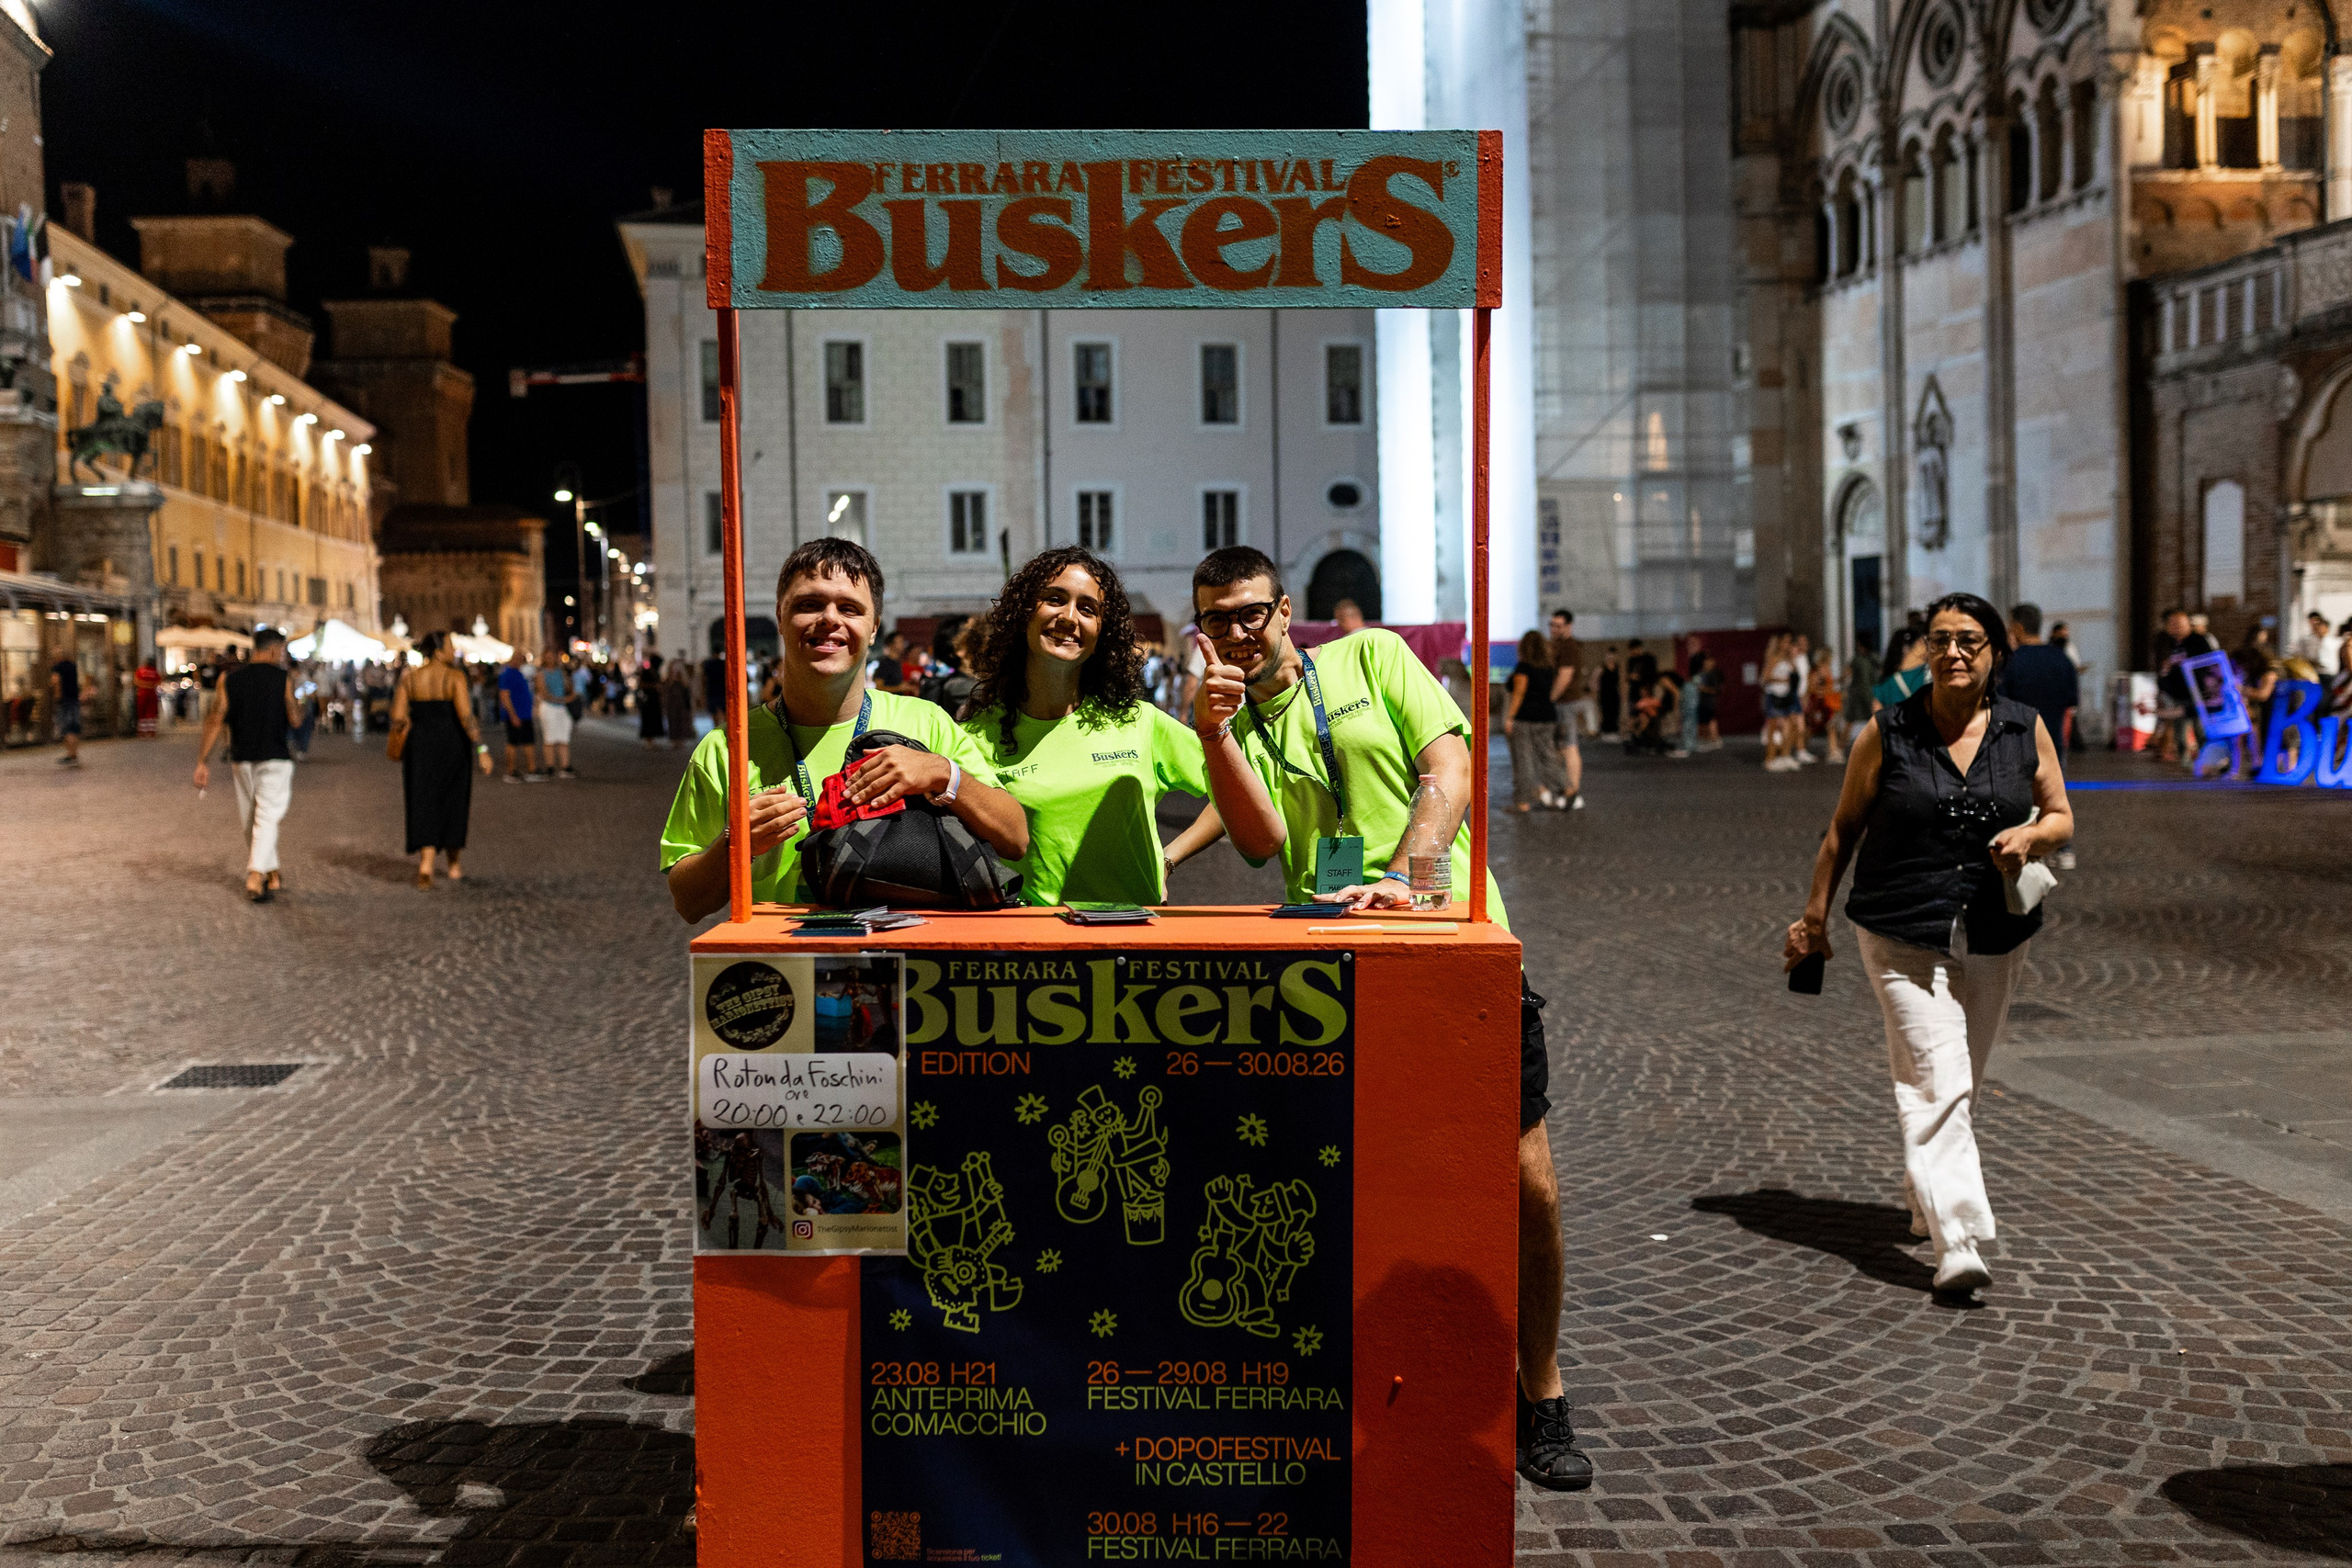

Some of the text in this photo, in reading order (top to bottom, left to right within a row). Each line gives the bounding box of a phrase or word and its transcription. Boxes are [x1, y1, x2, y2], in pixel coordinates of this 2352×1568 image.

[873, 160, 1351, 195] FERRARA FESTIVAL
[856, 694, 871, 732] USKERS
[1326, 697, 1370, 722] uskerS
[1327, 868, 1352, 877] STAFF
[948, 961, 1270, 980] FERRARA FESTIVAL
[716, 984, 780, 1013] THE GIPSY
[808, 1060, 883, 1089] Foschini
[921, 1052, 1031, 1076] EDITION
[1166, 1052, 1199, 1076] 26
[1238, 1052, 1345, 1077] 30.08.26
[785, 1089, 809, 1100] ore
[713, 1099, 788, 1127] 20:00
[813, 1104, 887, 1125] 22:00
[871, 1361, 996, 1386] 23.08 H21
[1087, 1360, 1120, 1385] 26
[1158, 1360, 1227, 1385] 29.08
[1242, 1361, 1290, 1386] H19
[871, 1387, 1035, 1410] ANTEPRIMA
[1088, 1386, 1344, 1410] FESTIVAL FERRARA
[871, 1412, 1047, 1436] COMACCHIO
[1136, 1437, 1341, 1461] DOPOFESTIVAL
[1136, 1462, 1306, 1486] IN CASTELLO
[1087, 1511, 1158, 1535] 30.08
[1172, 1512, 1219, 1536] H16
[1257, 1512, 1289, 1536] 22
[1088, 1537, 1343, 1560] FESTIVAL FERRARA
